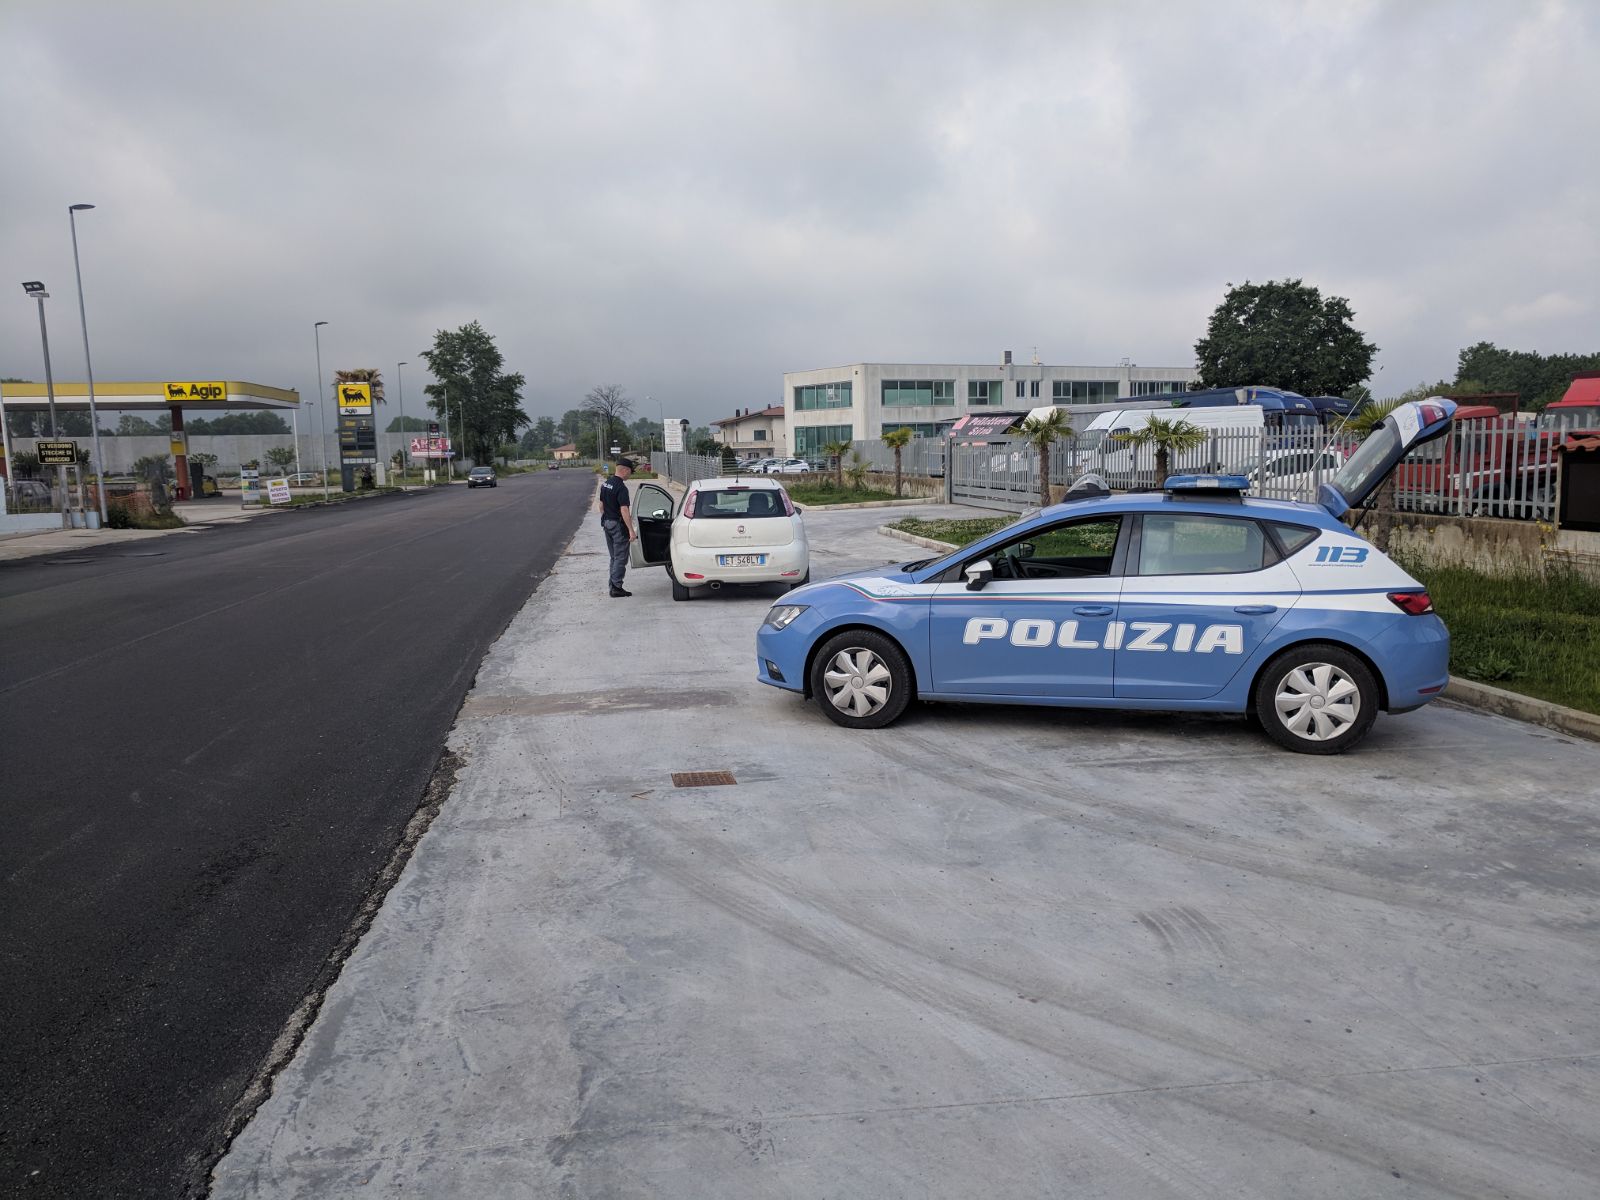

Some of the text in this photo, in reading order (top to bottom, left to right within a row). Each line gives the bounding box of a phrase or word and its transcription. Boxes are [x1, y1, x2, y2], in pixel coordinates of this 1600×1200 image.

[189, 383, 222, 400] Agip
[344, 407, 358, 415] Agip
[725, 555, 734, 565] ET
[1315, 546, 1369, 563] 113
[962, 617, 1245, 655] POLIZIA
